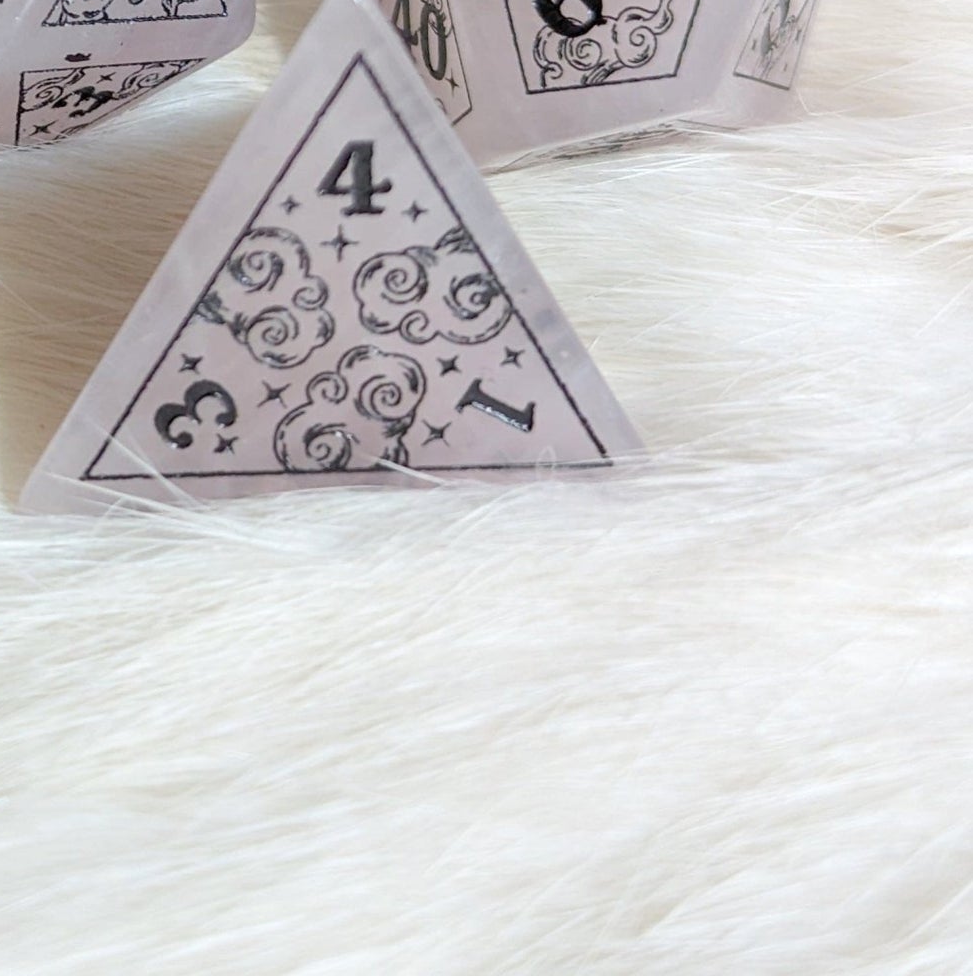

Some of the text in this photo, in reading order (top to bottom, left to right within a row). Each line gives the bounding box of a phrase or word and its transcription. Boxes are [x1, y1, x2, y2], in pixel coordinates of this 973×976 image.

[317, 139, 392, 216] 4
[154, 379, 236, 450] 3
[455, 378, 537, 433] 1
